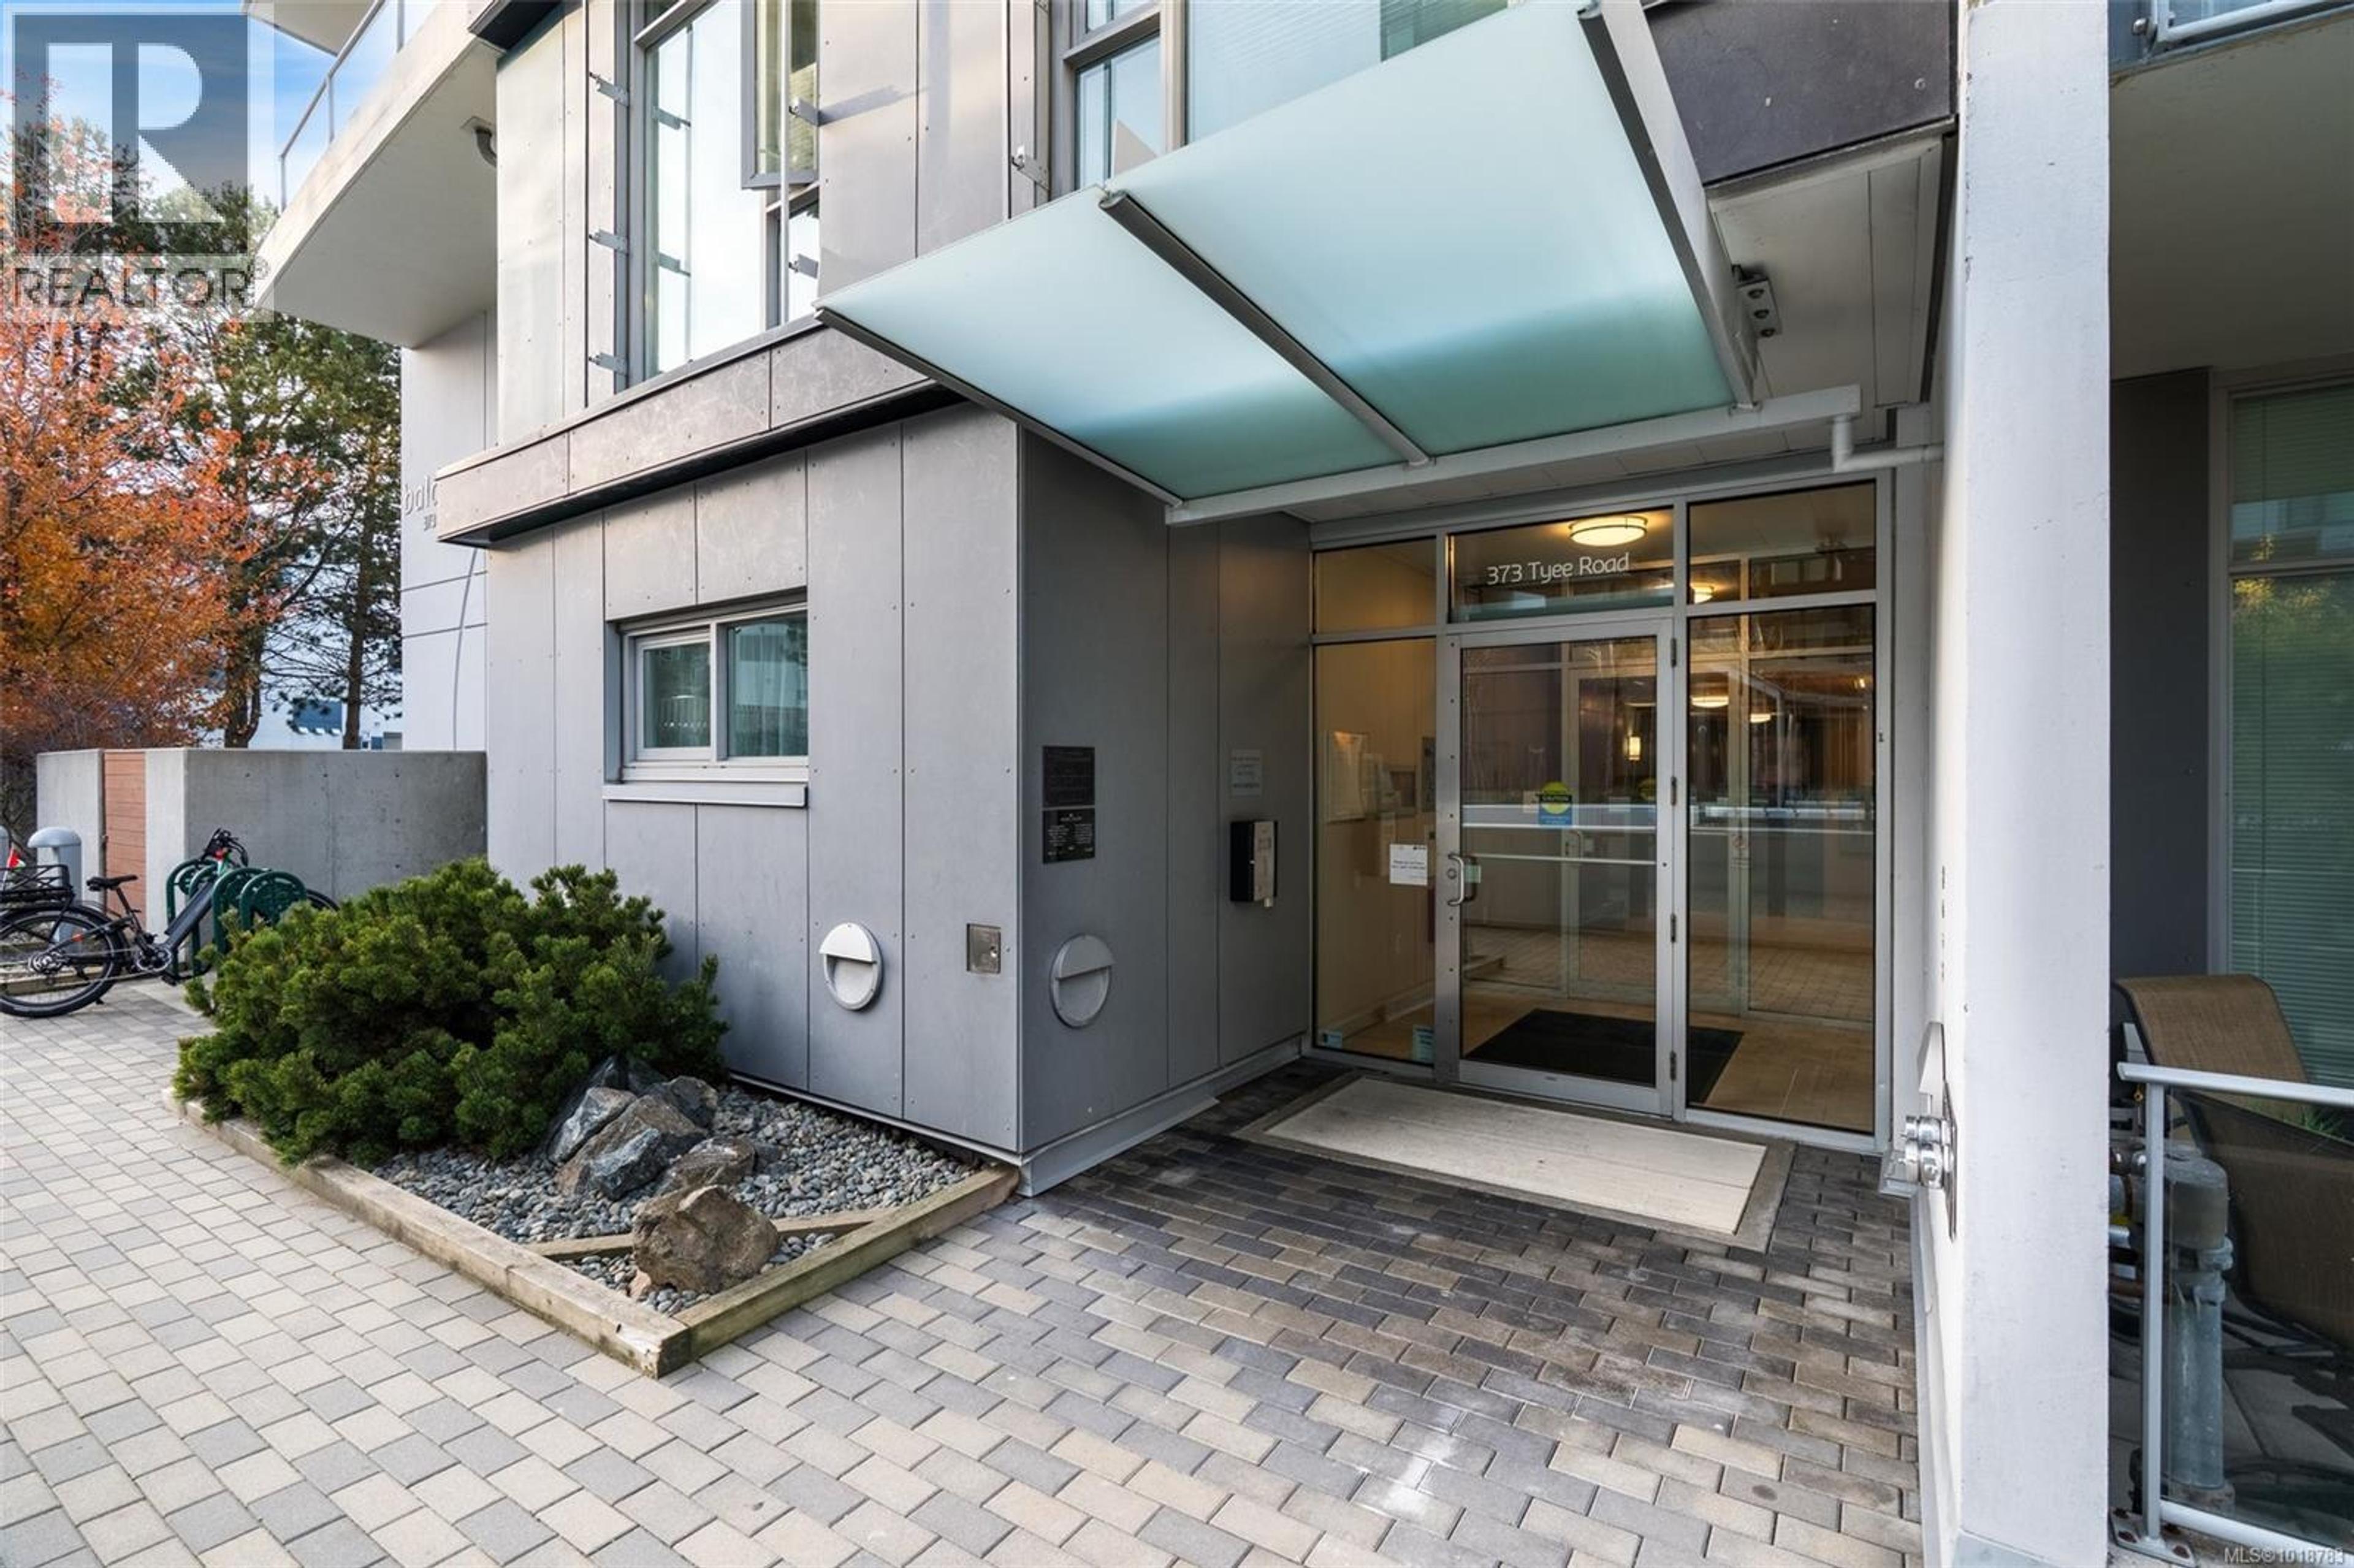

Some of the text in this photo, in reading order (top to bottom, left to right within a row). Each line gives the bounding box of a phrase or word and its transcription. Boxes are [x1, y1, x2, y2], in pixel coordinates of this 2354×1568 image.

[1487, 552, 1630, 585] 373 Tyee Road
